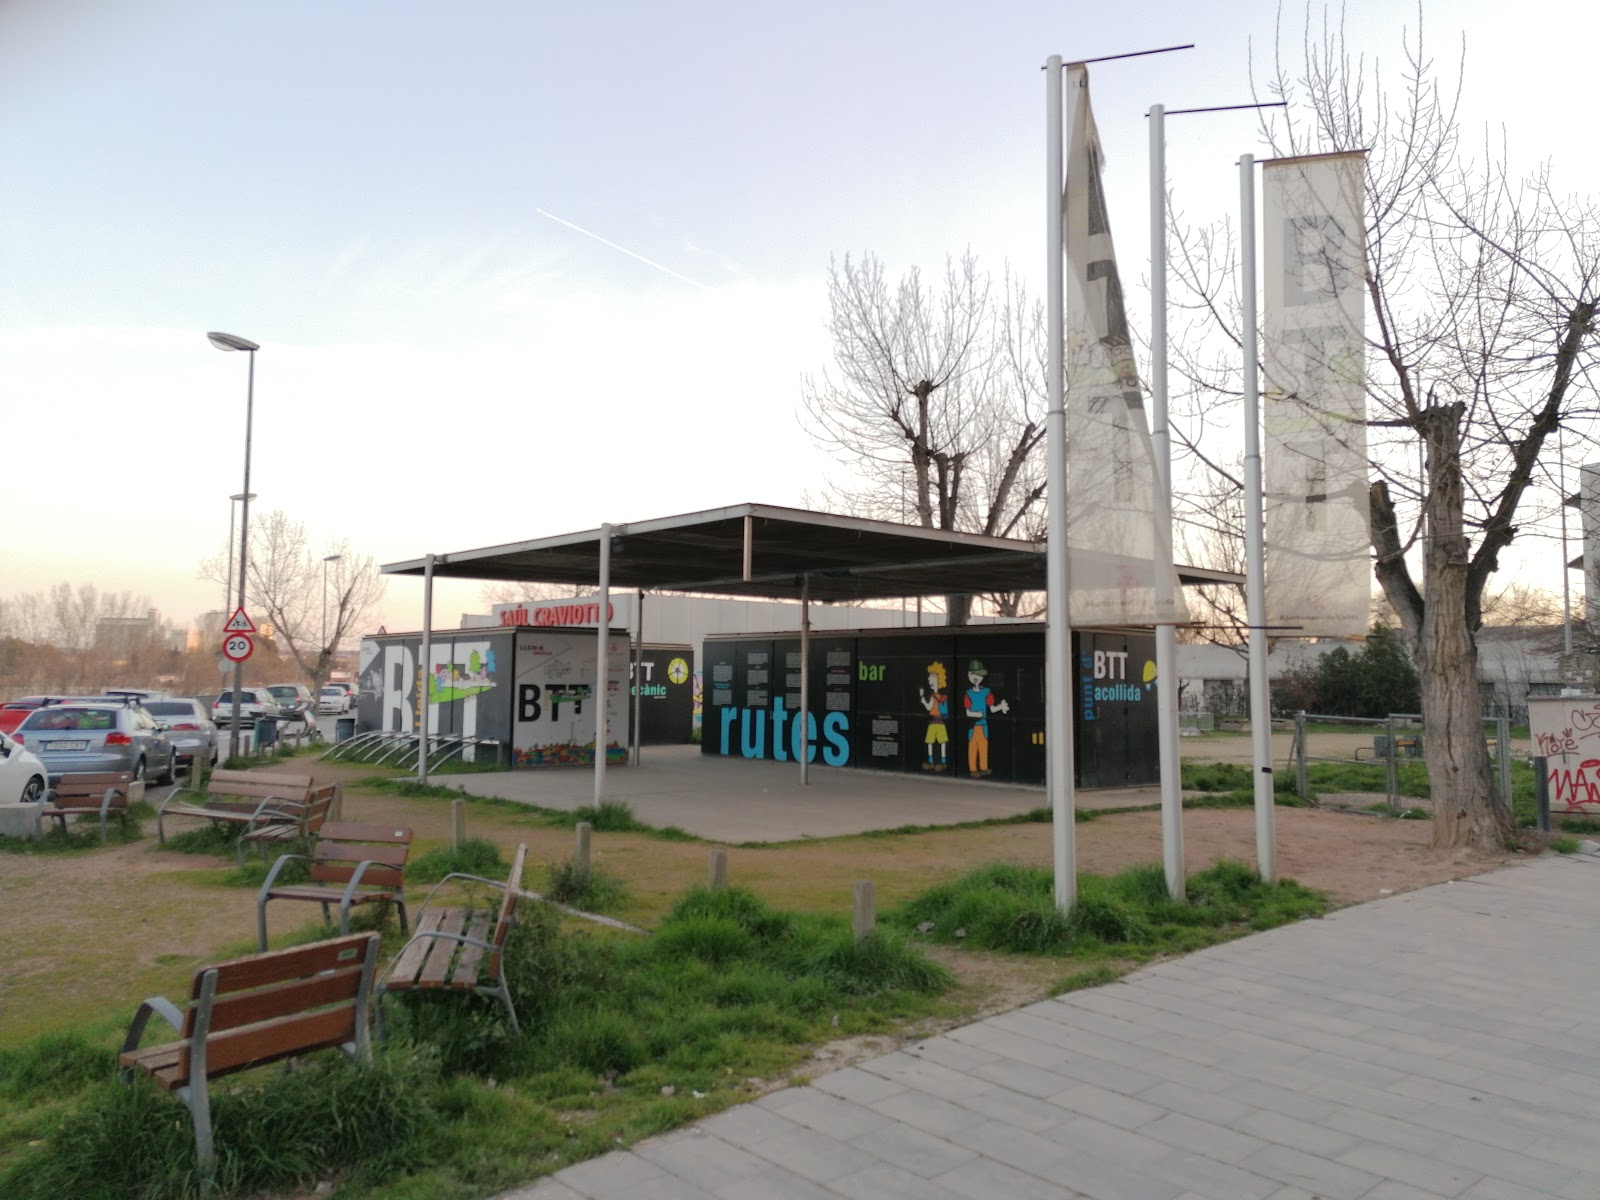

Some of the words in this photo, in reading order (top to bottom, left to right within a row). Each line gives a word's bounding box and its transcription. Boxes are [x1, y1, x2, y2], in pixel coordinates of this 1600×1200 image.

[499, 604, 529, 626] SAÚL
[229, 641, 246, 651] 20
[859, 661, 886, 682] bar
[1094, 650, 1128, 680] BTT
[1083, 677, 1095, 720] punt
[1094, 684, 1141, 701] acollida
[720, 696, 850, 767] rutes
